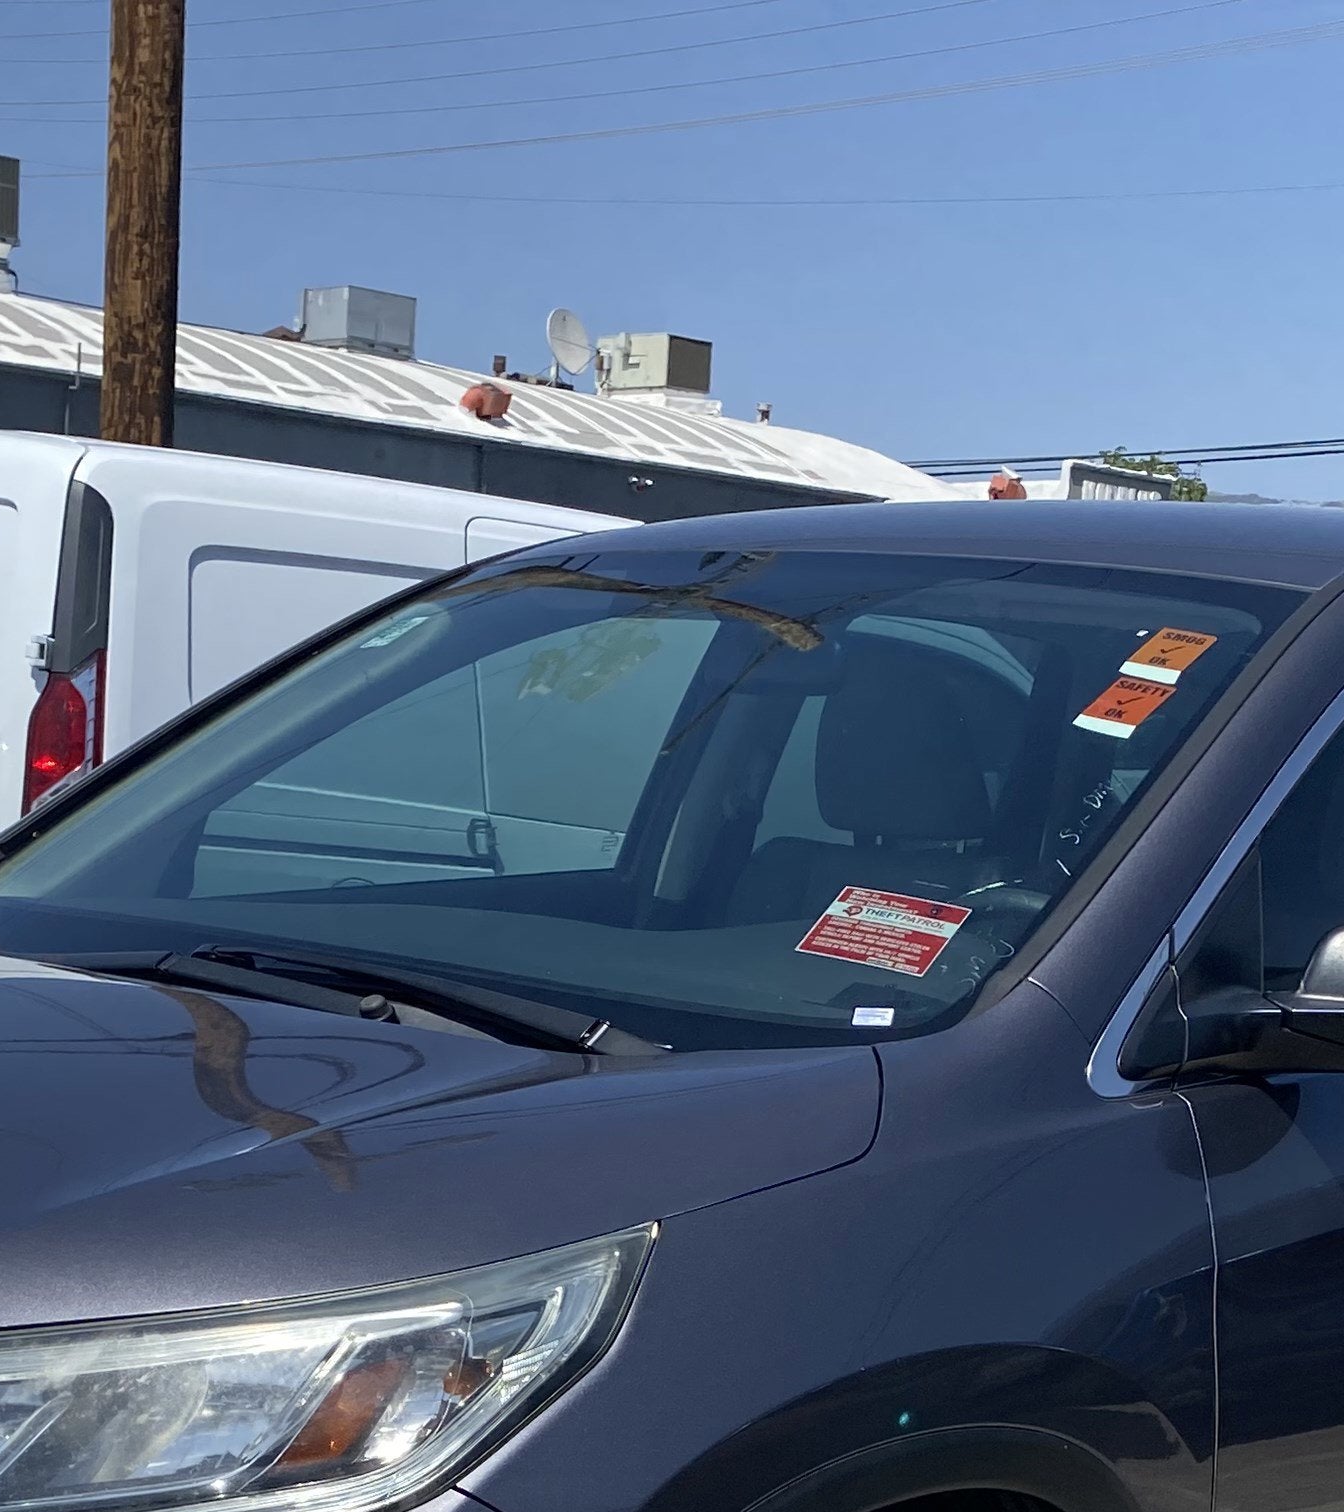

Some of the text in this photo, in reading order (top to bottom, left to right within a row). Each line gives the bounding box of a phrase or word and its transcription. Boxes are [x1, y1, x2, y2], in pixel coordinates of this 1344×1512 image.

[1163, 632, 1207, 645] SMOG
[1149, 656, 1168, 665] OK
[1117, 681, 1170, 697] SAFETY
[1105, 709, 1126, 719] OK
